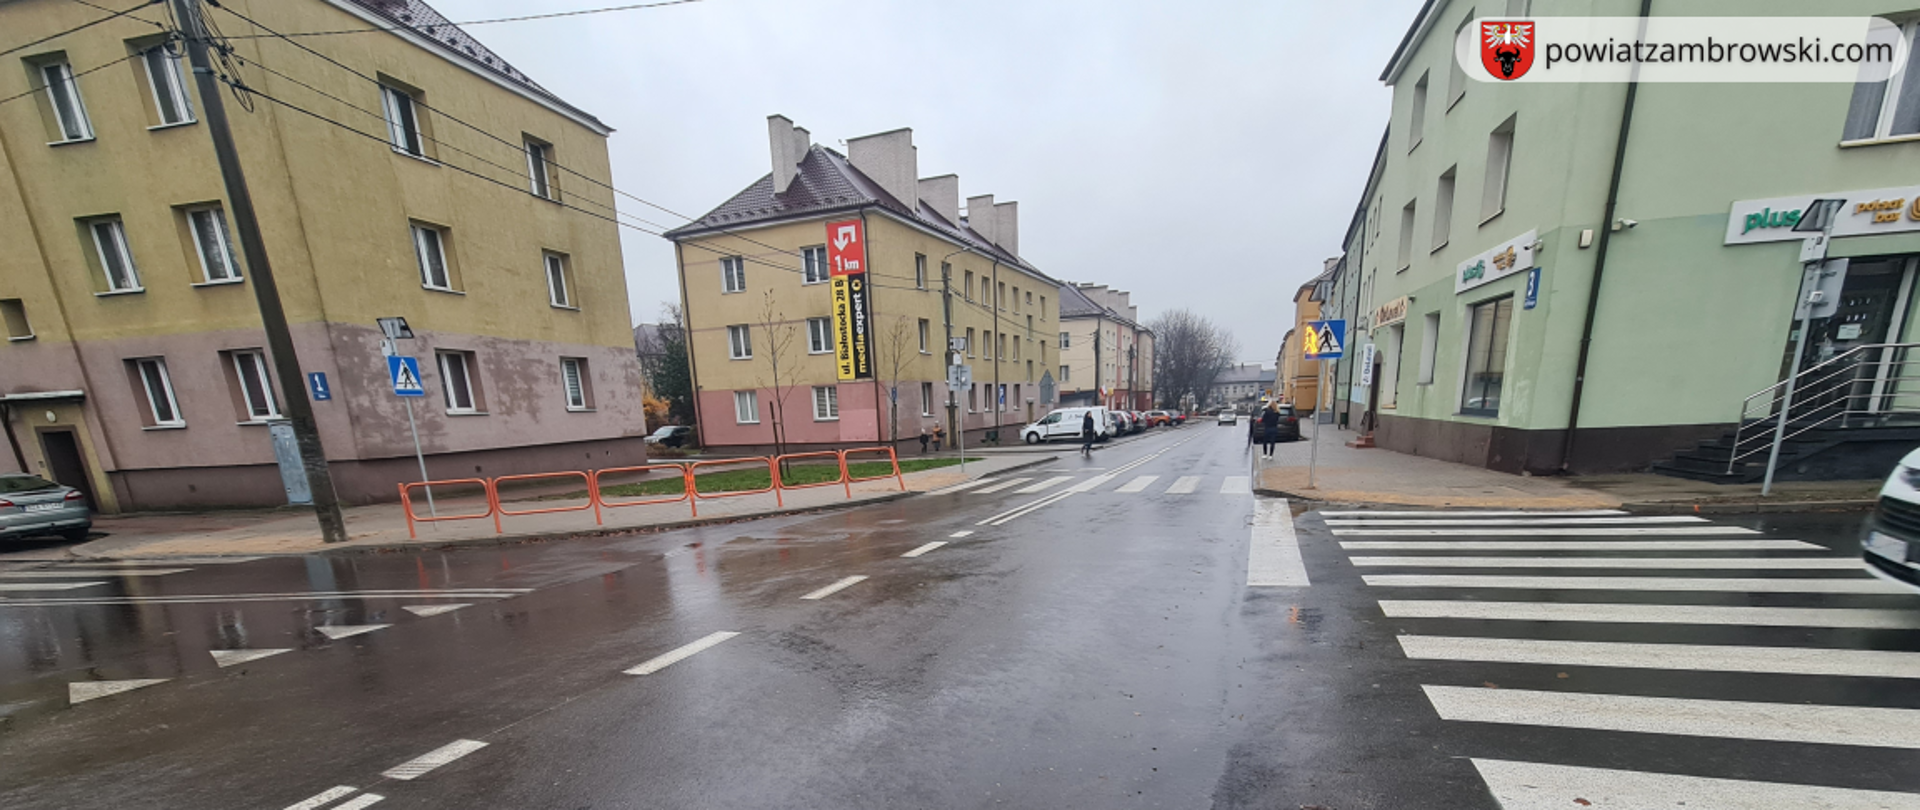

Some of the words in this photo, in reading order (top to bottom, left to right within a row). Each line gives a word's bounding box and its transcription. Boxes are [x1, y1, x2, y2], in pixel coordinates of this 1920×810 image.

[1744, 207, 1801, 234] plus
[834, 254, 842, 272] 1
[844, 257, 859, 271] km
[834, 279, 844, 288] B
[1527, 271, 1536, 297] 3
[835, 289, 846, 302] 28
[836, 303, 849, 360] Białostocka
[853, 294, 866, 373] mediaexpert
[841, 362, 851, 375] ul.
[314, 373, 324, 392] 1
